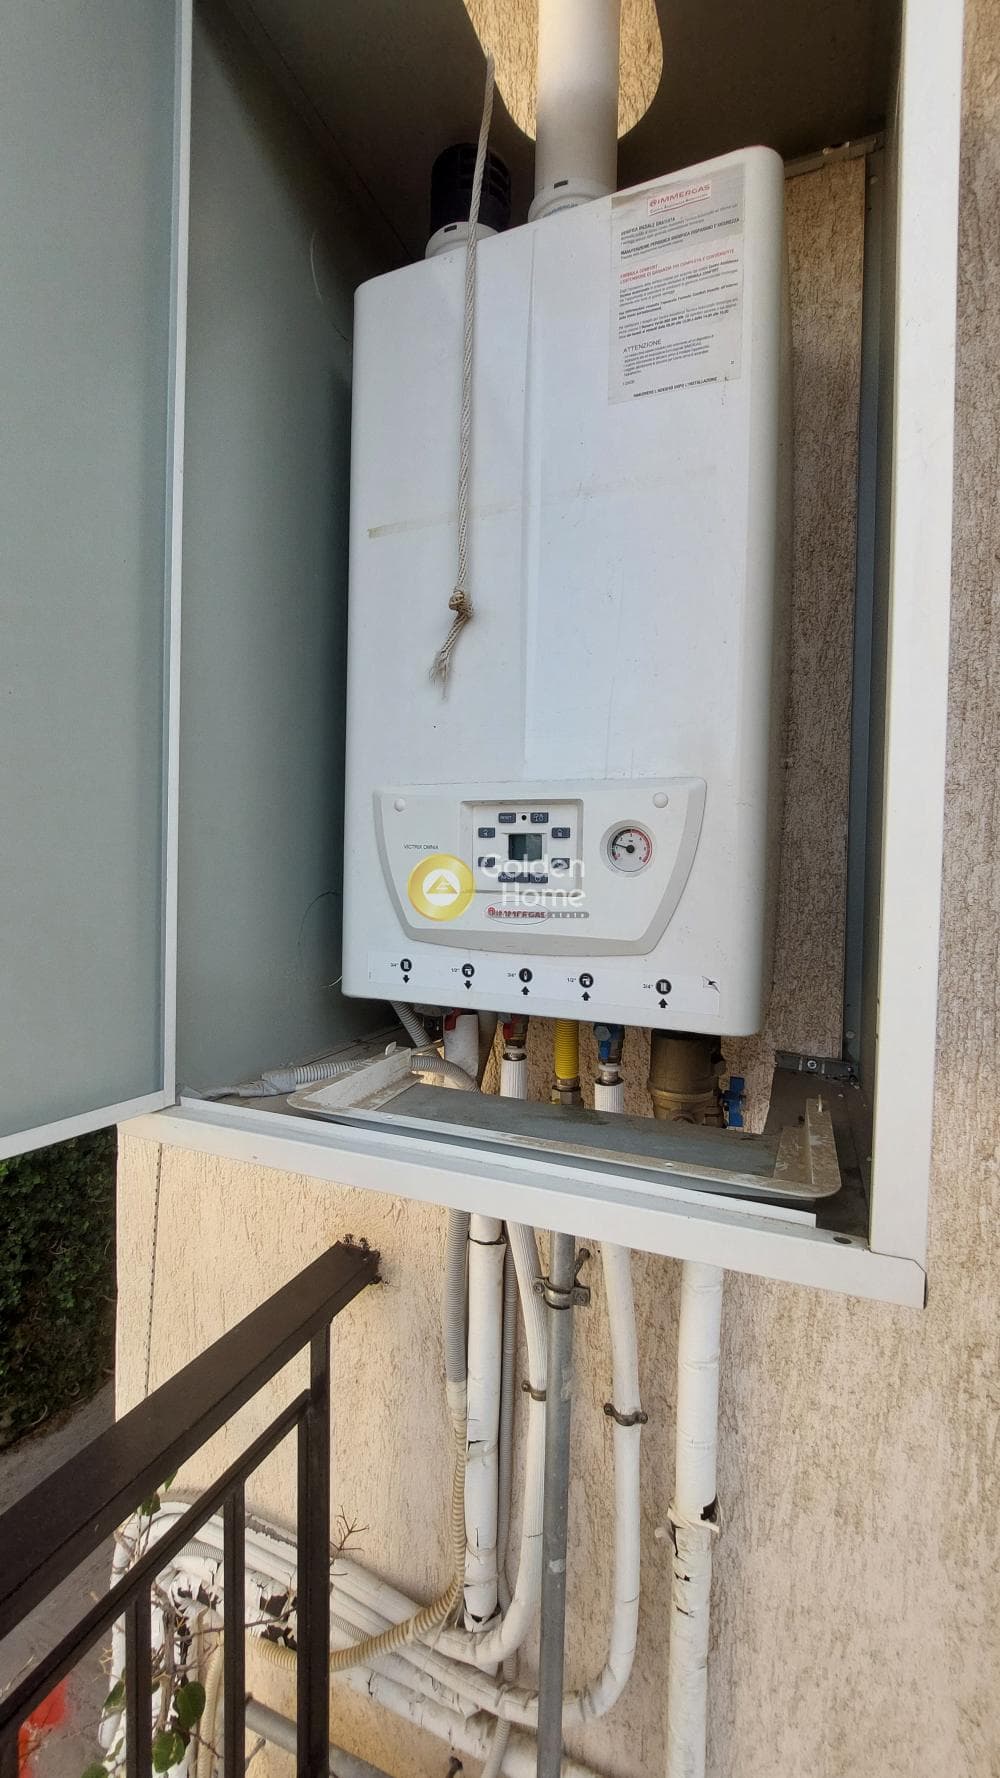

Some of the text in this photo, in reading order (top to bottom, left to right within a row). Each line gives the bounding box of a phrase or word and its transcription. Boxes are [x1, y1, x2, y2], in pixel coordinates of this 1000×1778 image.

[654, 184, 710, 205] IMMERGAS
[622, 338, 662, 353] ATTENZIONE
[493, 908, 546, 919] IMMERGAS
